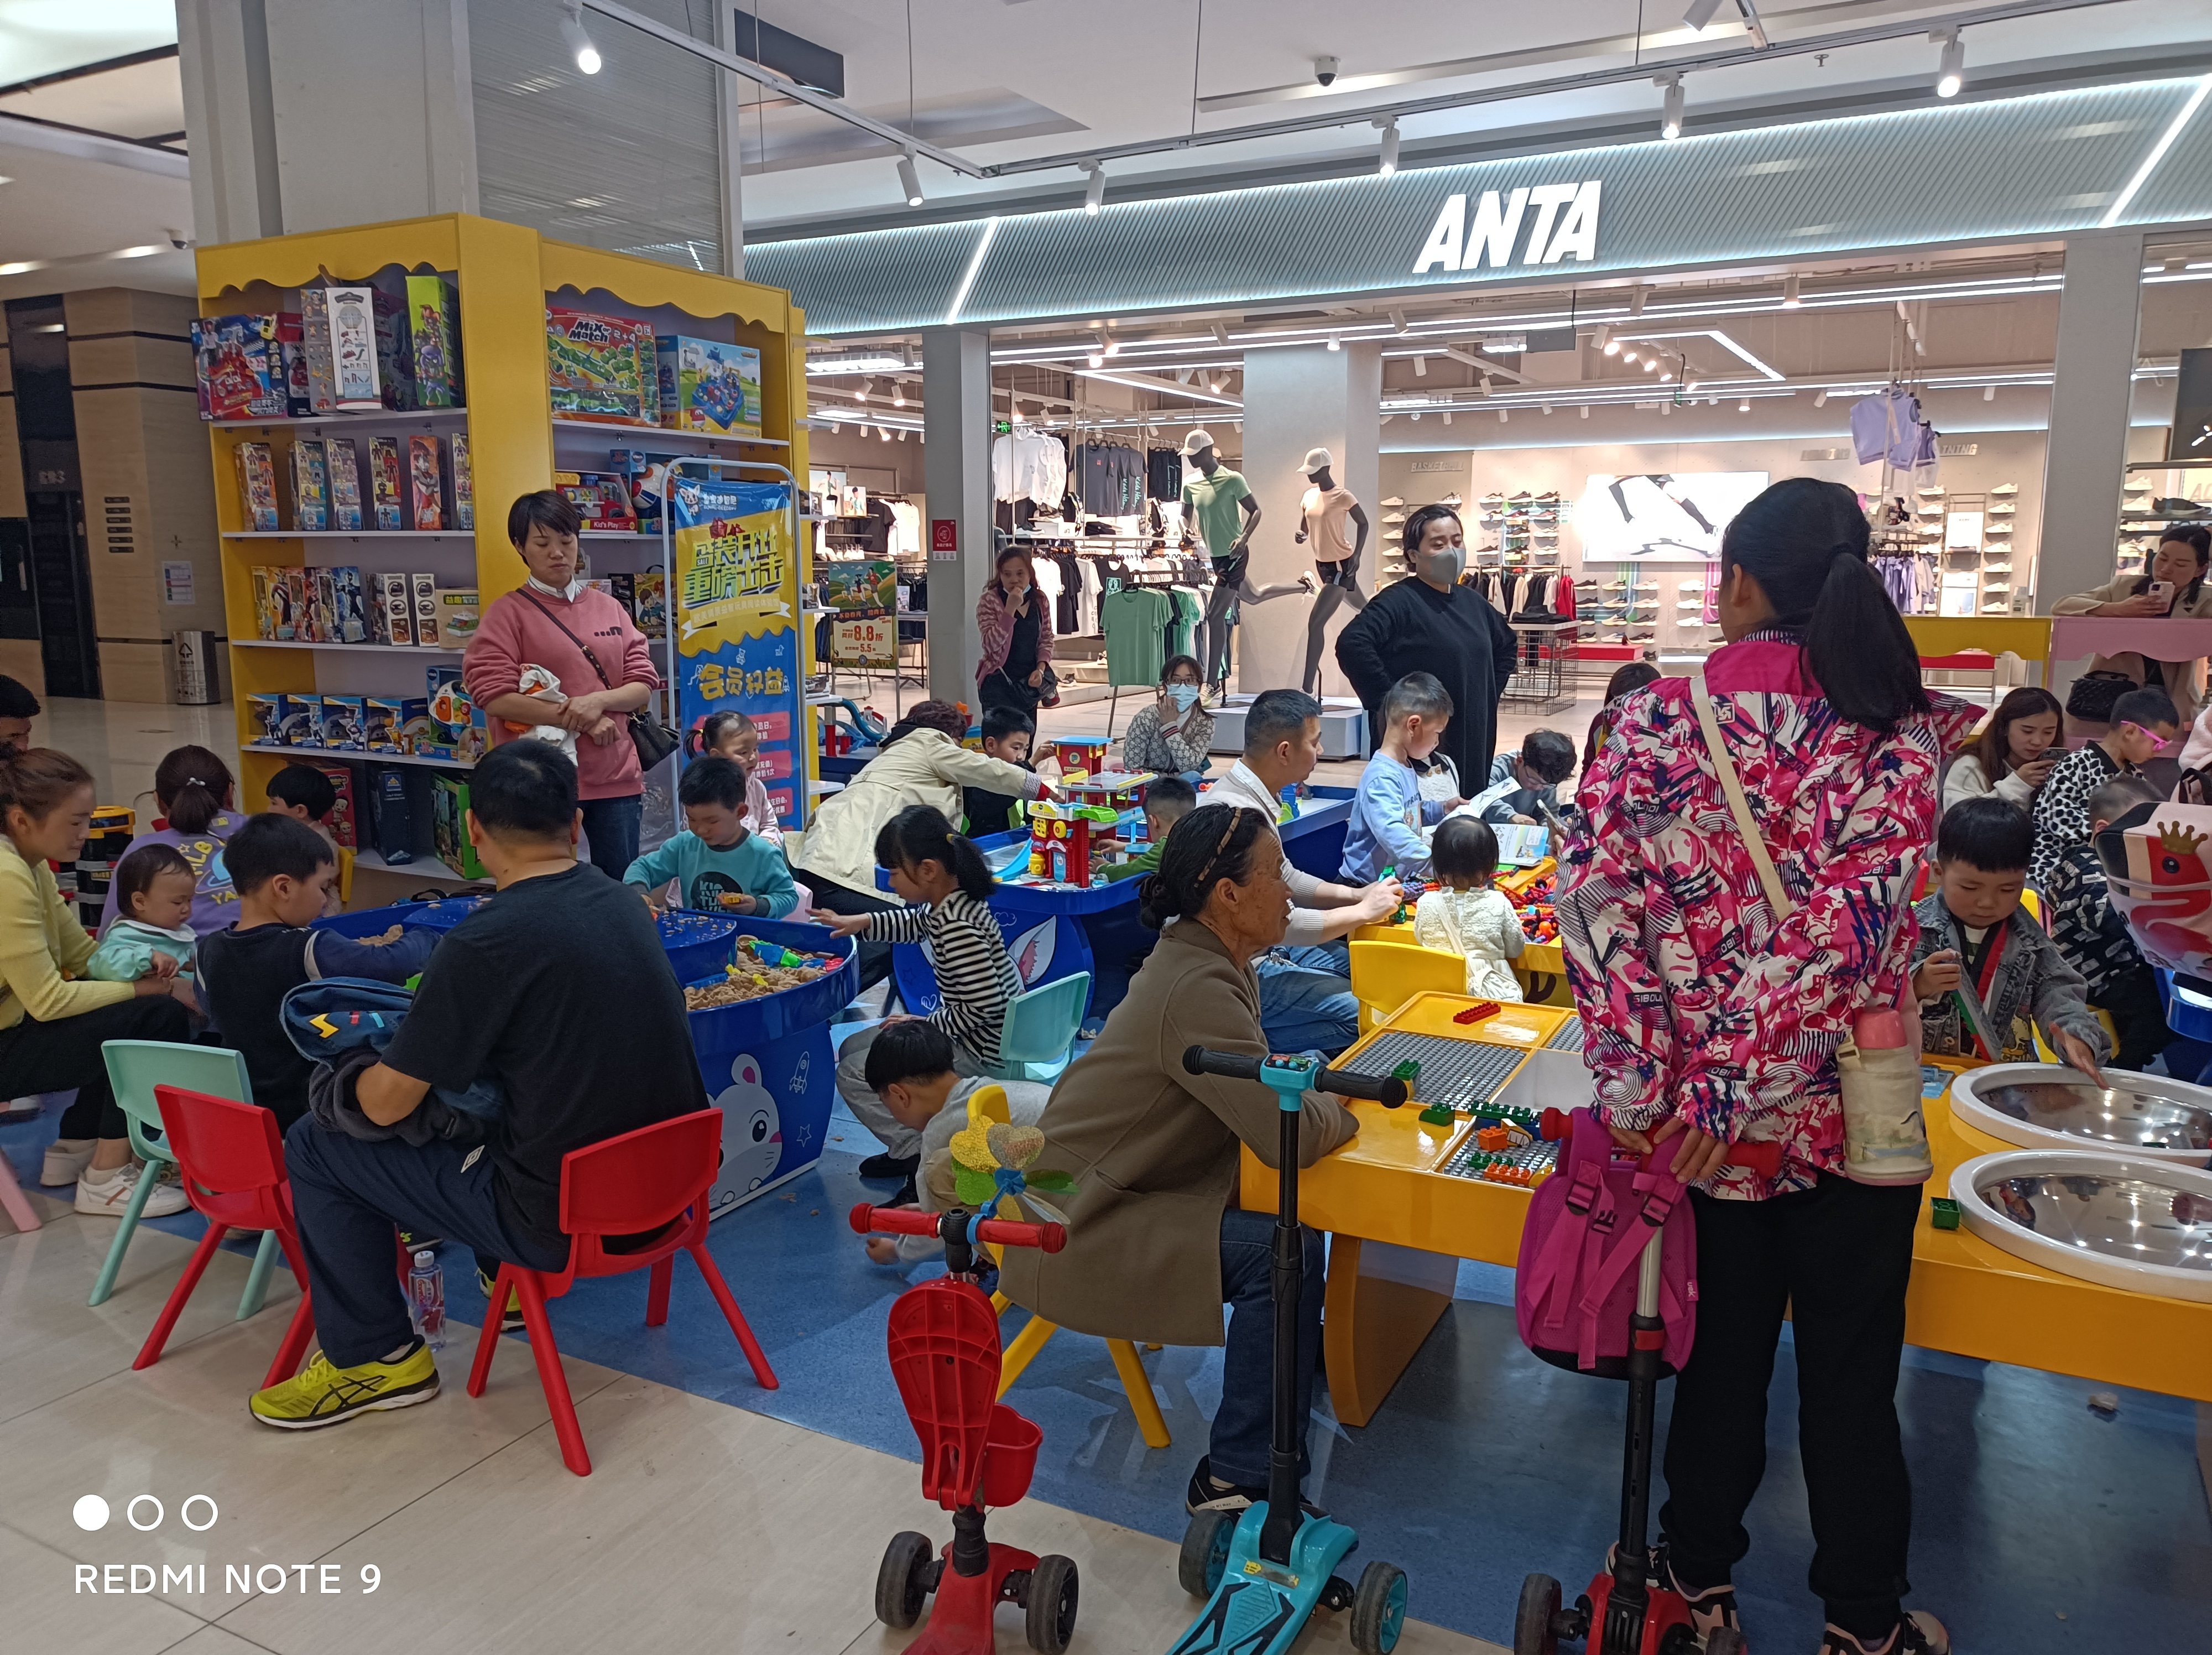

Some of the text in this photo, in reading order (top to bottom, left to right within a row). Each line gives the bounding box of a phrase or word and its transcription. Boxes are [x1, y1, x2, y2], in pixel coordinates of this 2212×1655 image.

[1412, 180, 1601, 273] ANTA
[568, 330, 608, 342] Match
[691, 524, 778, 571] 盛装开业
[684, 555, 784, 604] 重磅出击
[699, 663, 783, 700] 会员权益
